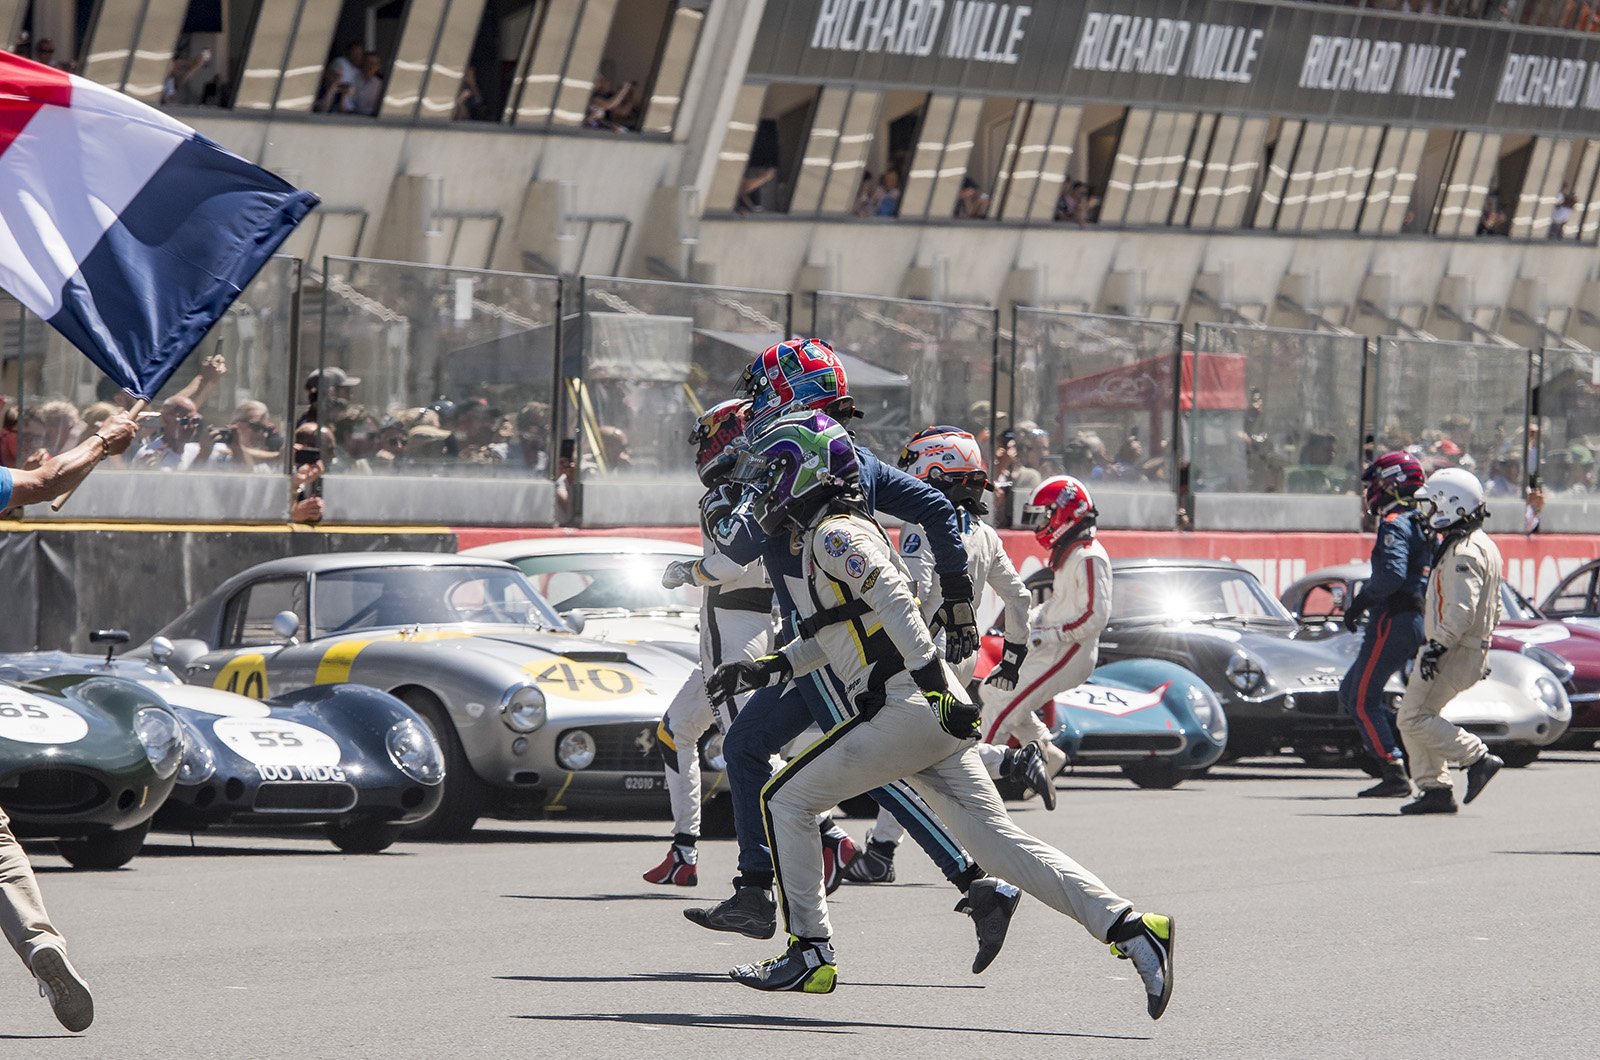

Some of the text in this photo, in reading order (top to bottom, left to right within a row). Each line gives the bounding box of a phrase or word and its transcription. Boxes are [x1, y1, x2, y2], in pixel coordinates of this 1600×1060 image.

[811, 0, 1031, 64] RICHARD MILLE
[1073, 12, 1263, 83] RICHARD MILLE
[1299, 35, 1466, 99] RICHARD MILLE
[1496, 53, 1587, 108] RICHARD
[535, 663, 633, 694] 40
[0, 703, 49, 718] 65
[1075, 691, 1128, 706] 24
[250, 731, 303, 747] 55
[256, 764, 347, 782] 100 MDG
